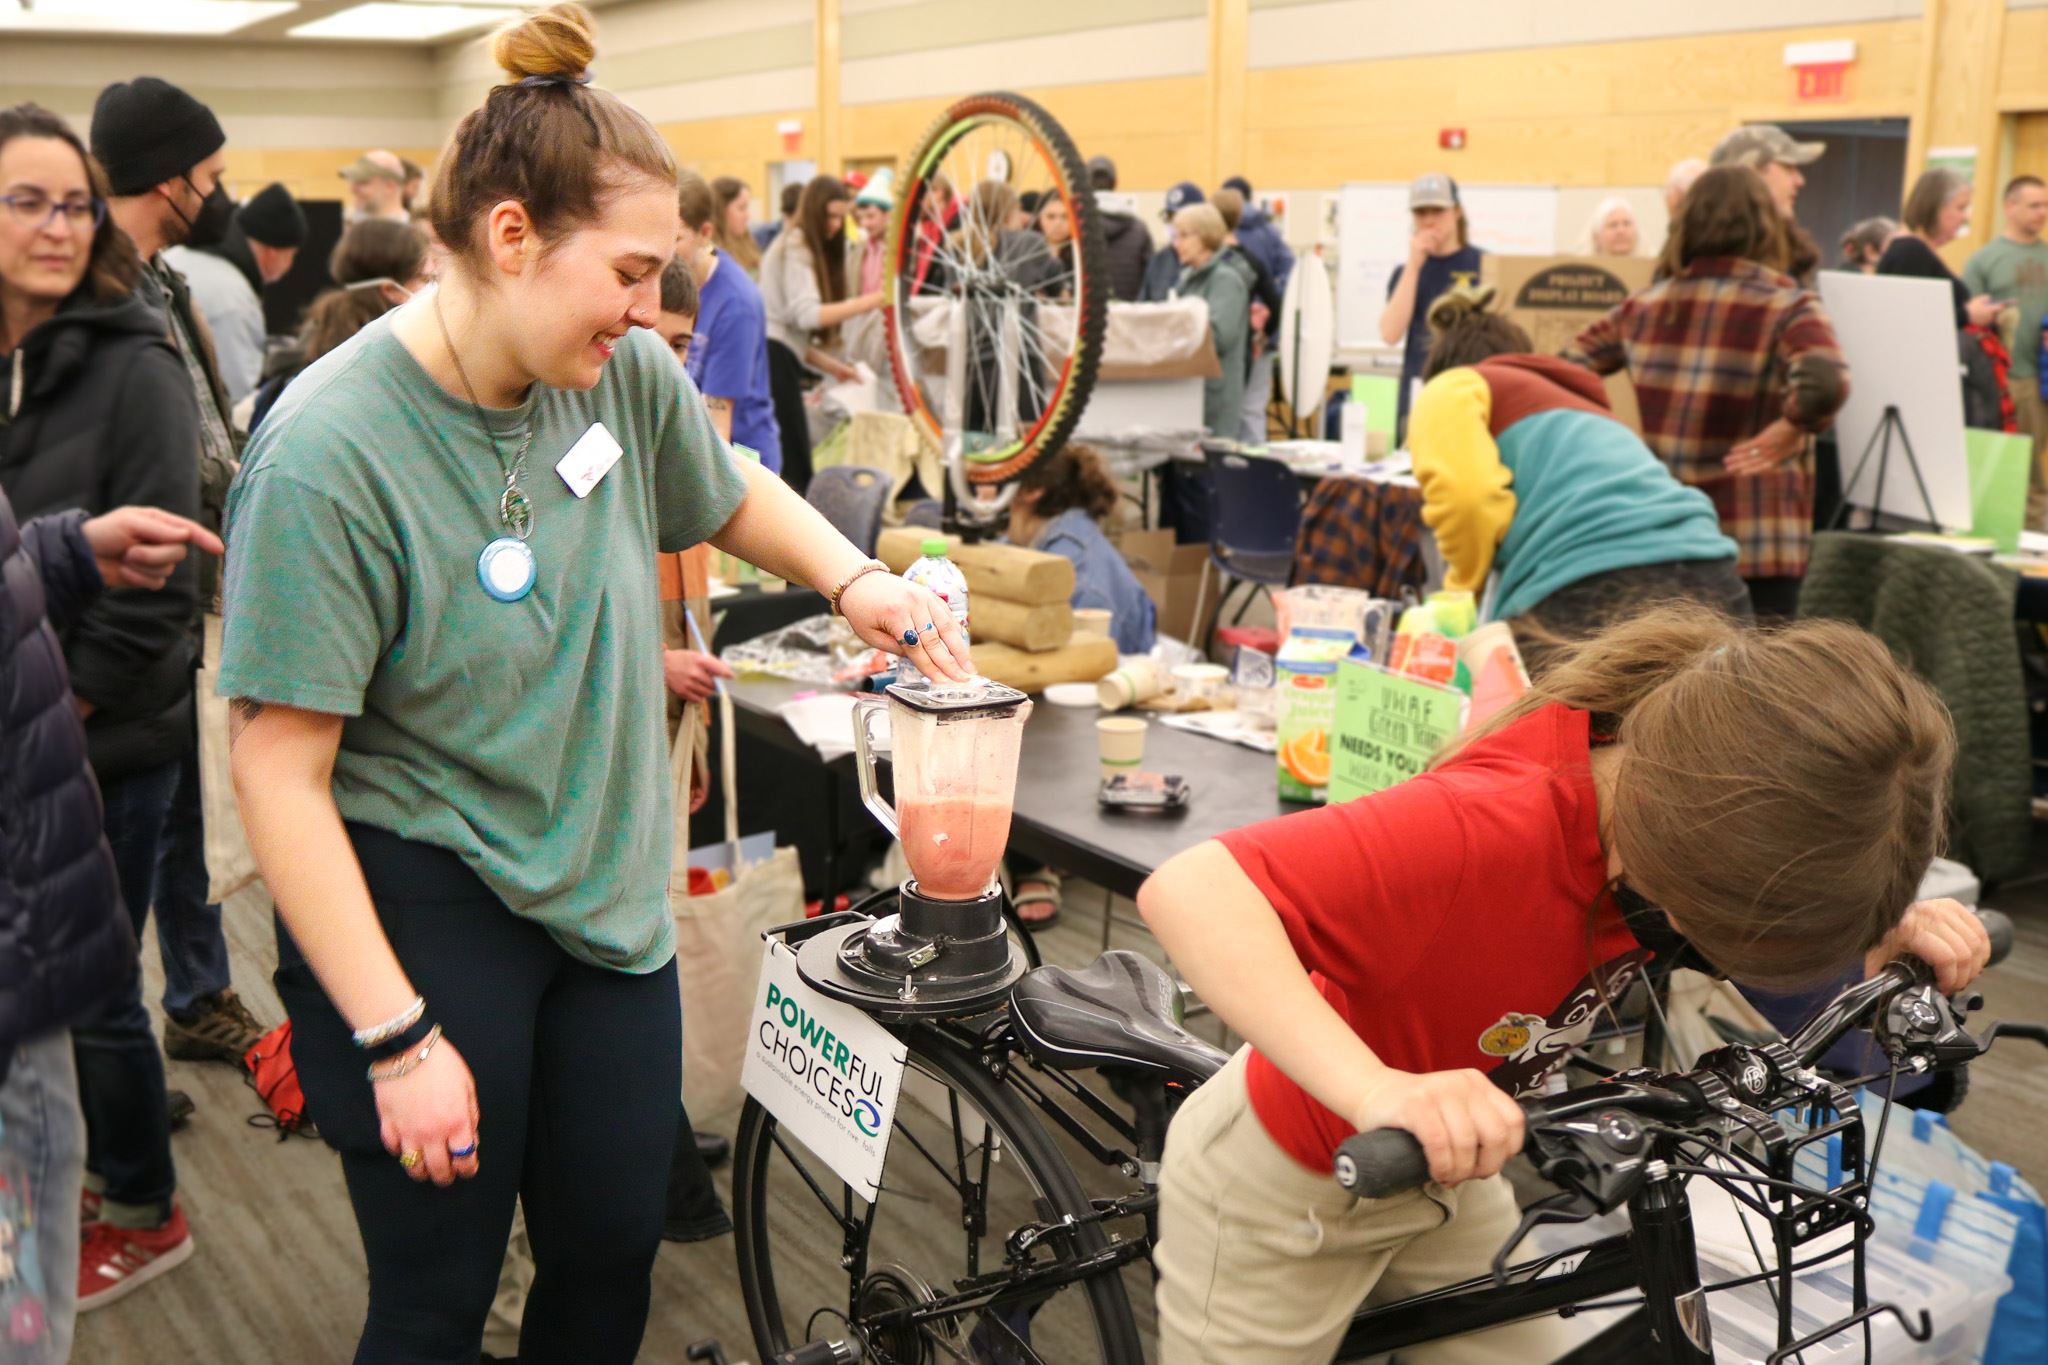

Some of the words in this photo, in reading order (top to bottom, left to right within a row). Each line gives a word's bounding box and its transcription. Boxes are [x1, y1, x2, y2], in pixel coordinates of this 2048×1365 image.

[1339, 733, 1383, 762] NEEDS
[1386, 748, 1419, 775] YOU
[759, 1020, 855, 1117] CHOICES
[766, 983, 883, 1107] POWERFUL
[793, 1084, 814, 1105] energy
[814, 1102, 836, 1121] project
[837, 1118, 847, 1131] for
[862, 1140, 876, 1157] falls
